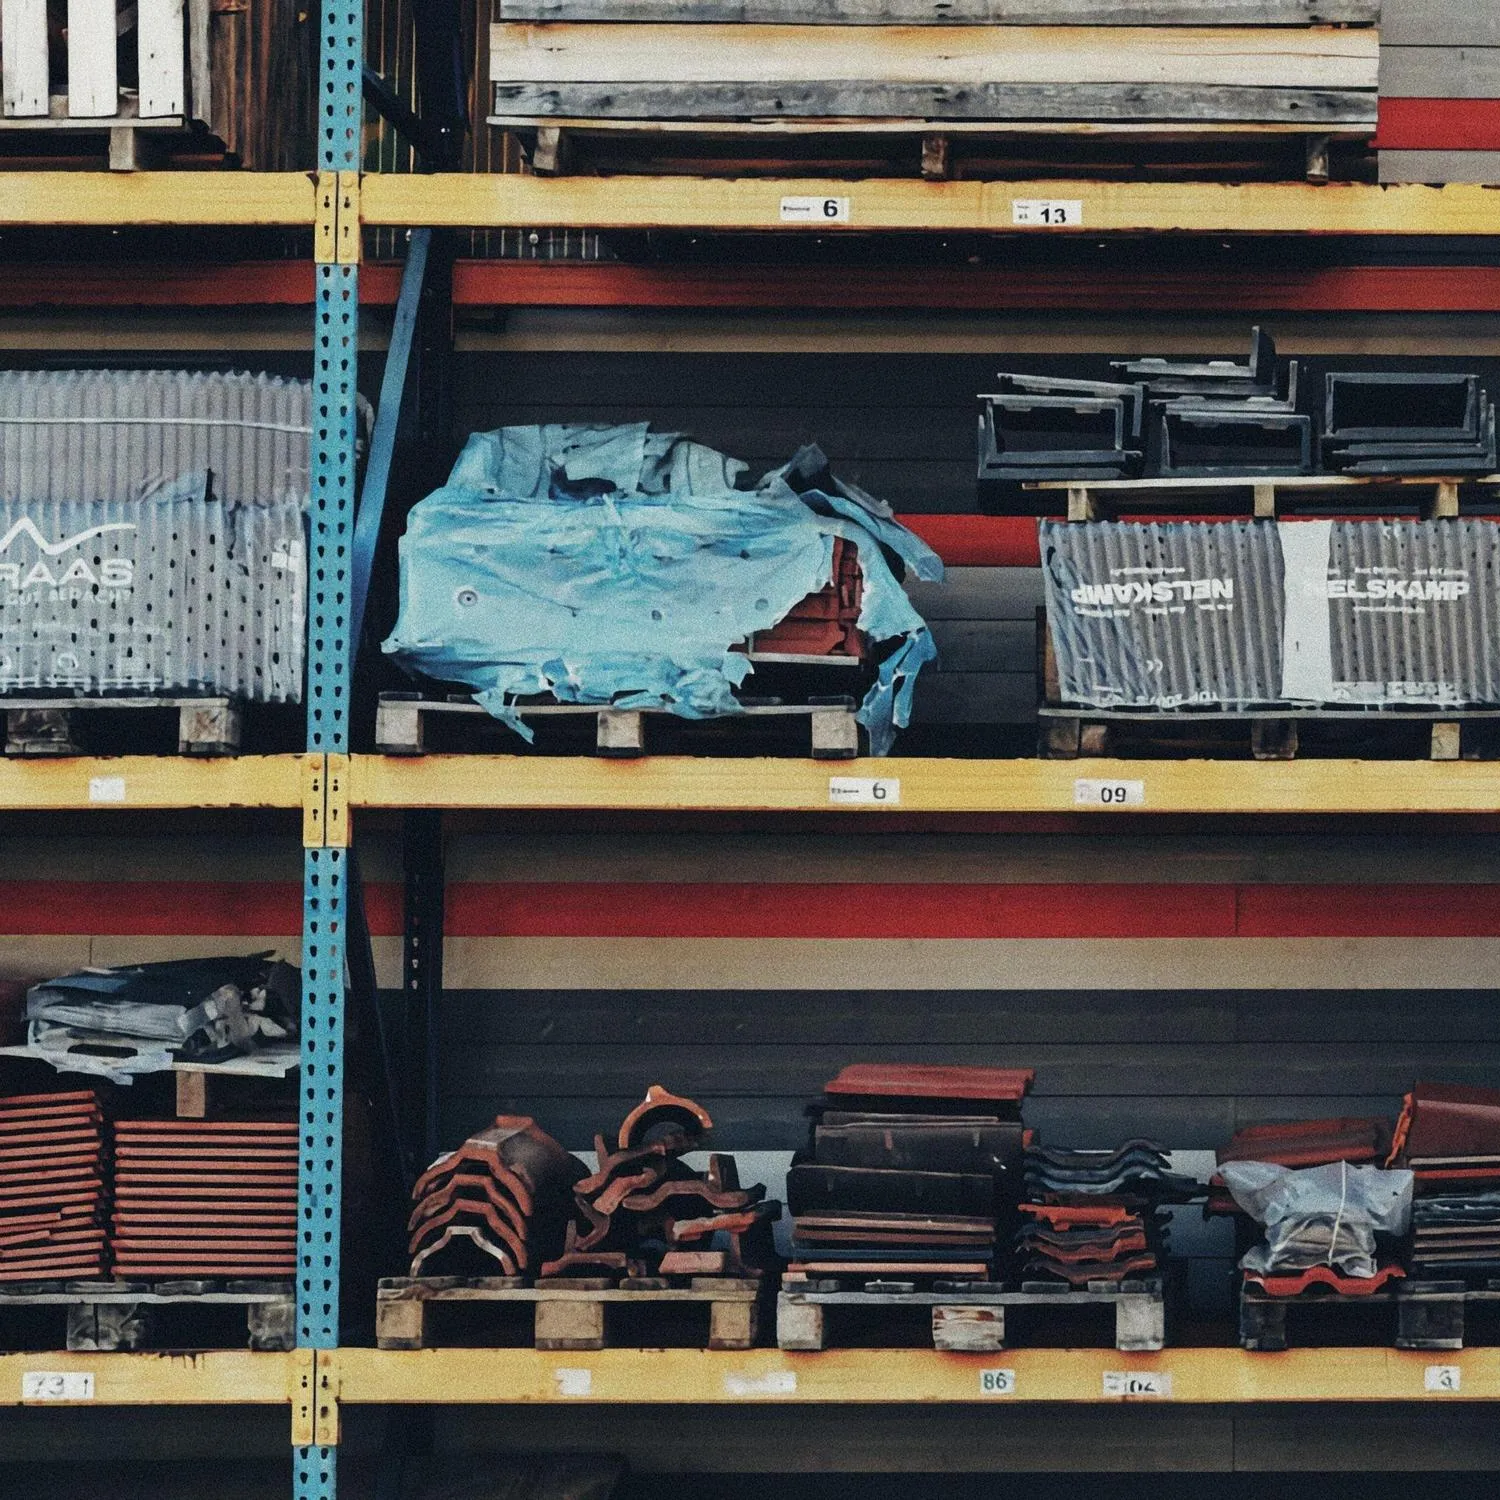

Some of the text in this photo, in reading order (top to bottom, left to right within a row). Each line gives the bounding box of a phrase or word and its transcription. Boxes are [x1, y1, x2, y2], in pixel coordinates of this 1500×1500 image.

[823, 199, 838, 218] 6
[1041, 208, 1067, 224] 13
[1071, 578, 1233, 605] NELSKAMP
[1325, 579, 1470, 601] ELSKAMP
[873, 782, 886, 799] 6
[1101, 787, 1126, 803] 09
[984, 1373, 1008, 1391] 86
